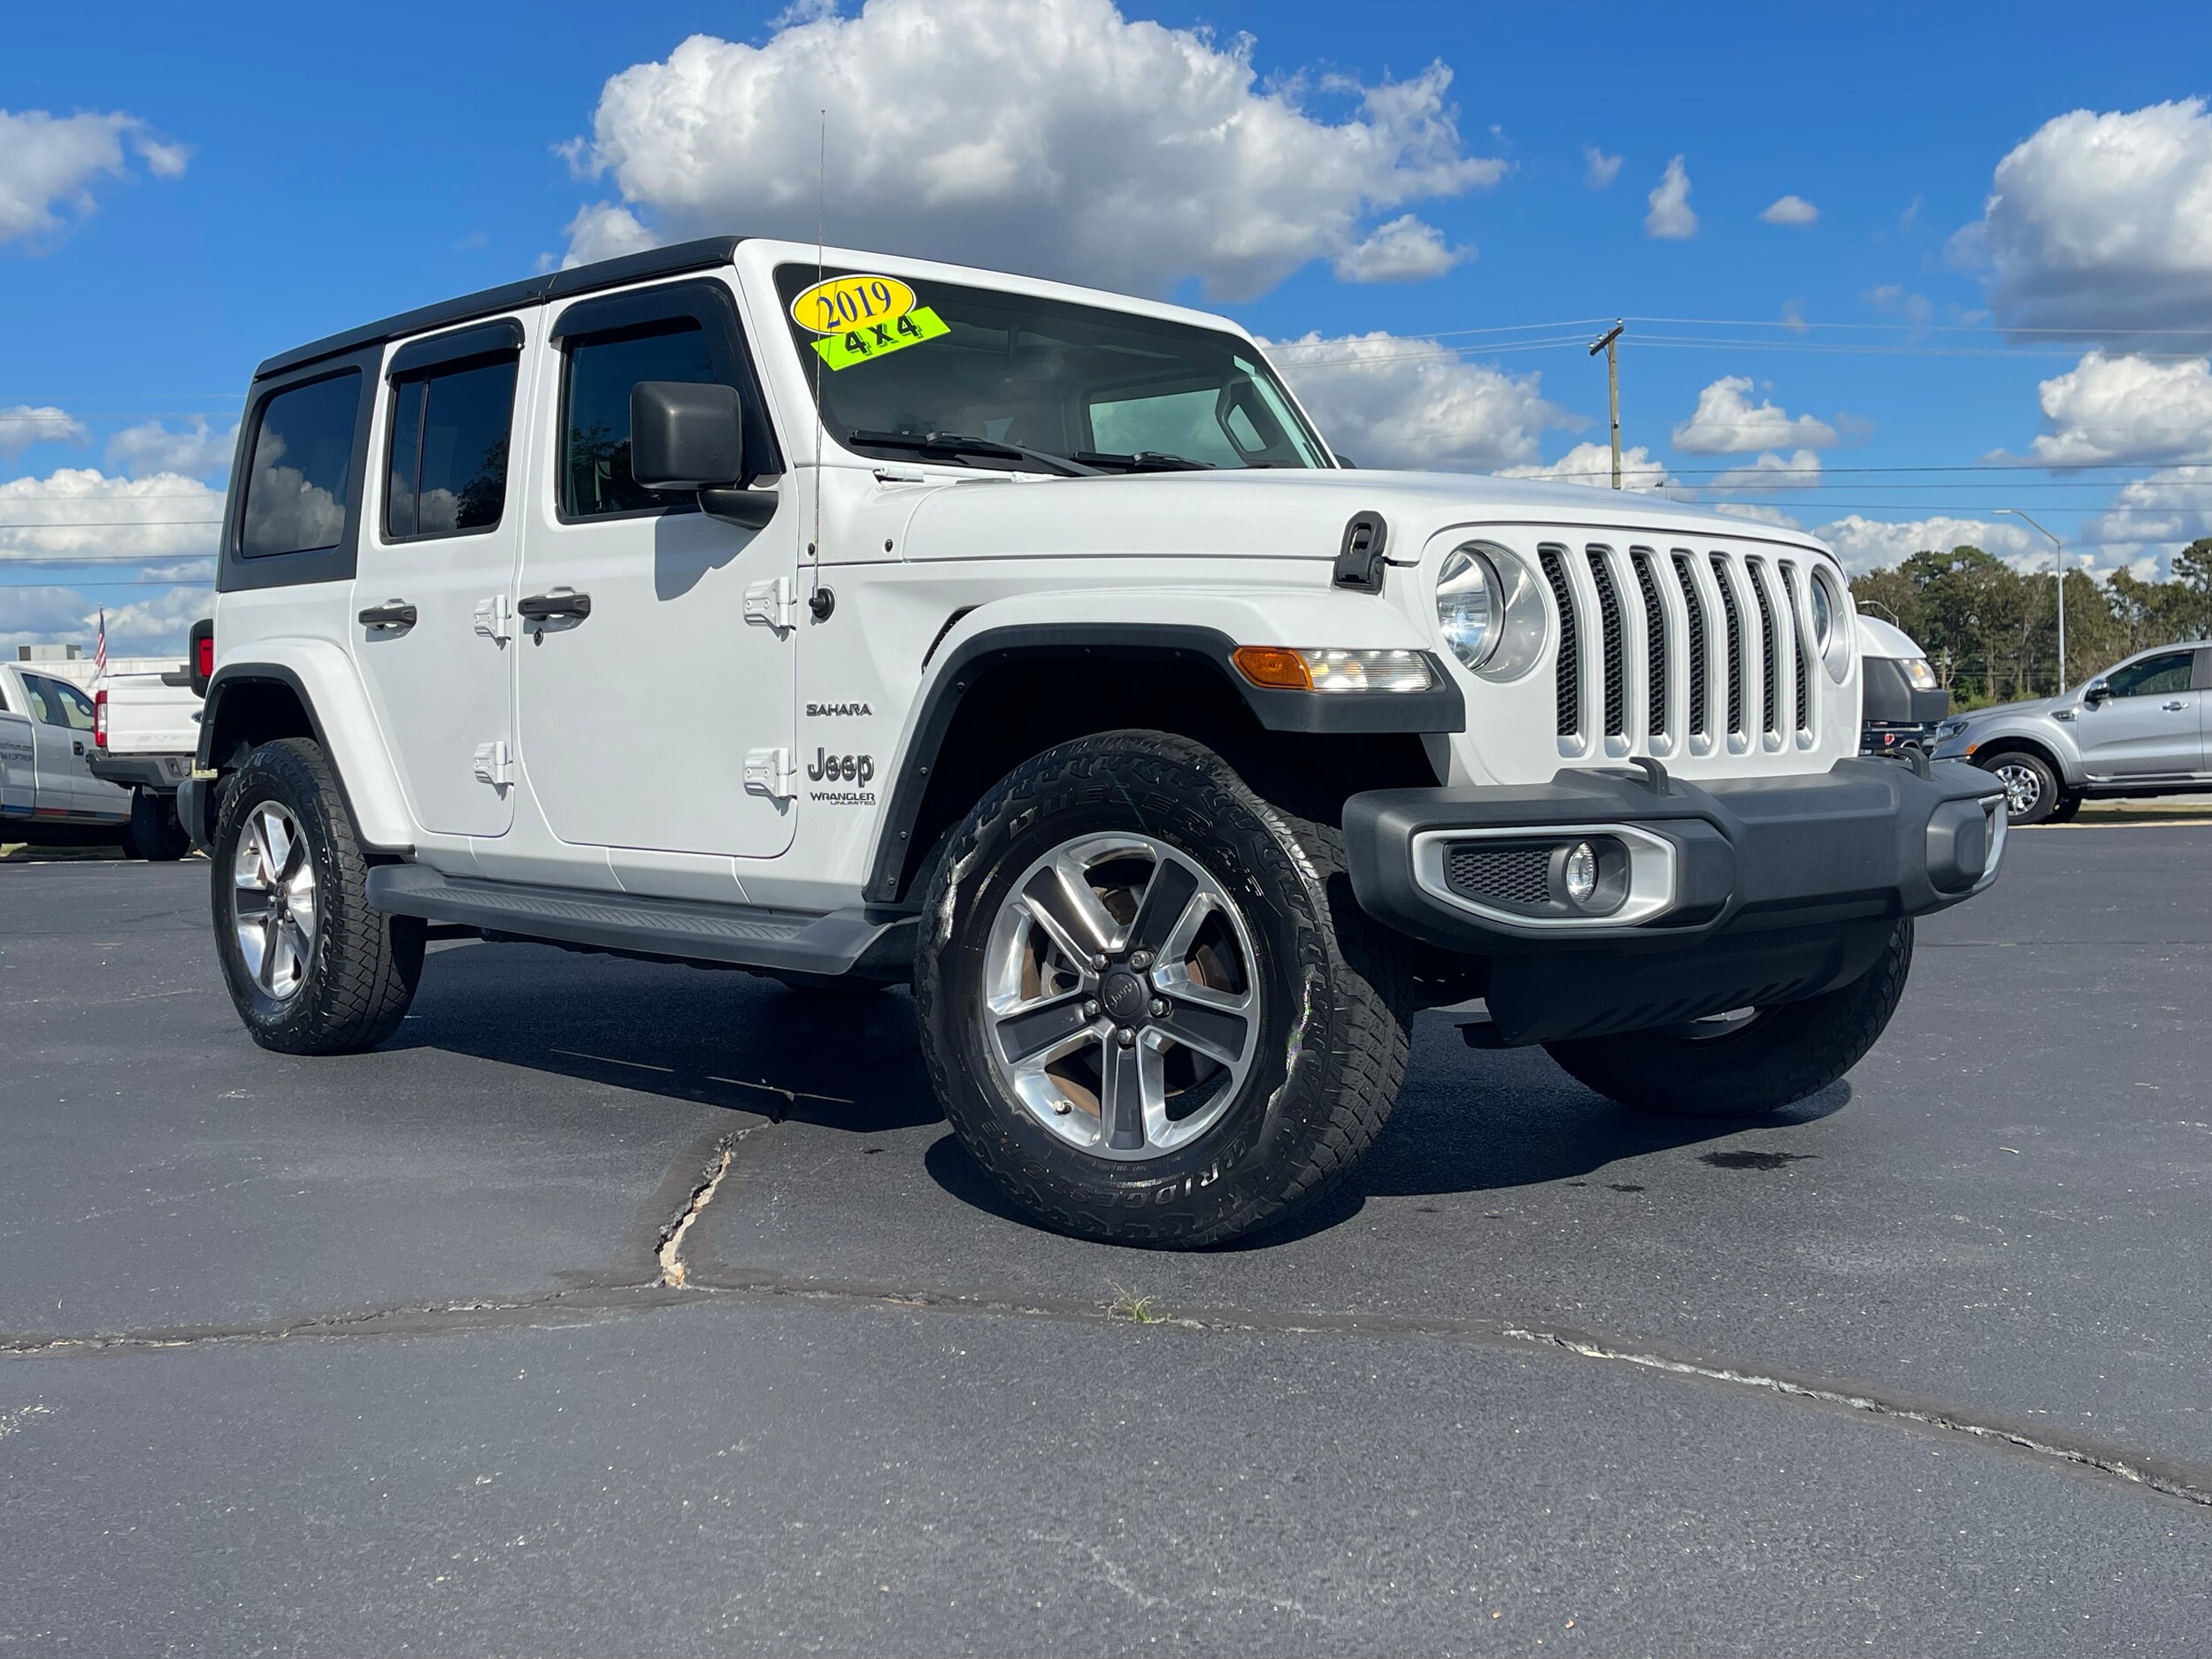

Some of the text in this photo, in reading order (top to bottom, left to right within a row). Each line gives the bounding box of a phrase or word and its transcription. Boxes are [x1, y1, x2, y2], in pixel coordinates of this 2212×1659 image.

[817, 281, 892, 328] 2019
[806, 703, 872, 717] SAHARA
[807, 747, 875, 788] Jeep
[810, 791, 875, 802] WRANGLER
